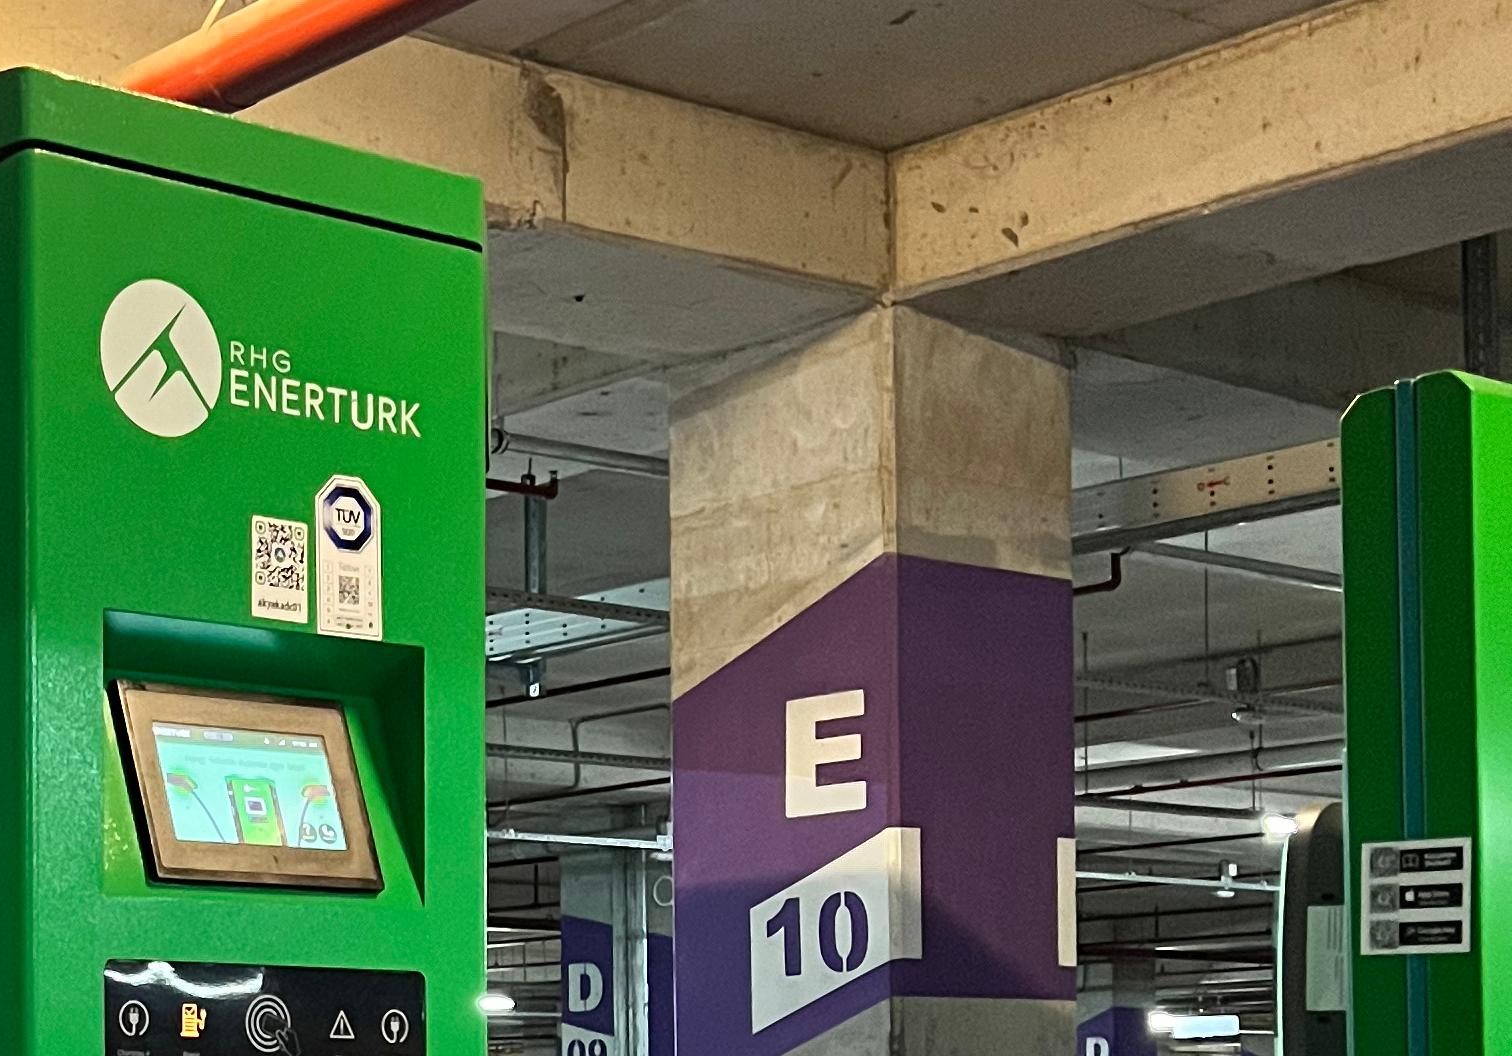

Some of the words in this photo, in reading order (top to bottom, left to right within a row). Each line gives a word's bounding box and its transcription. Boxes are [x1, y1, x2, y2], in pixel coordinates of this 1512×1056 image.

[230, 341, 291, 372] RHG
[786, 689, 867, 818] E
[766, 891, 869, 976] 10
[568, 962, 604, 1012] D
